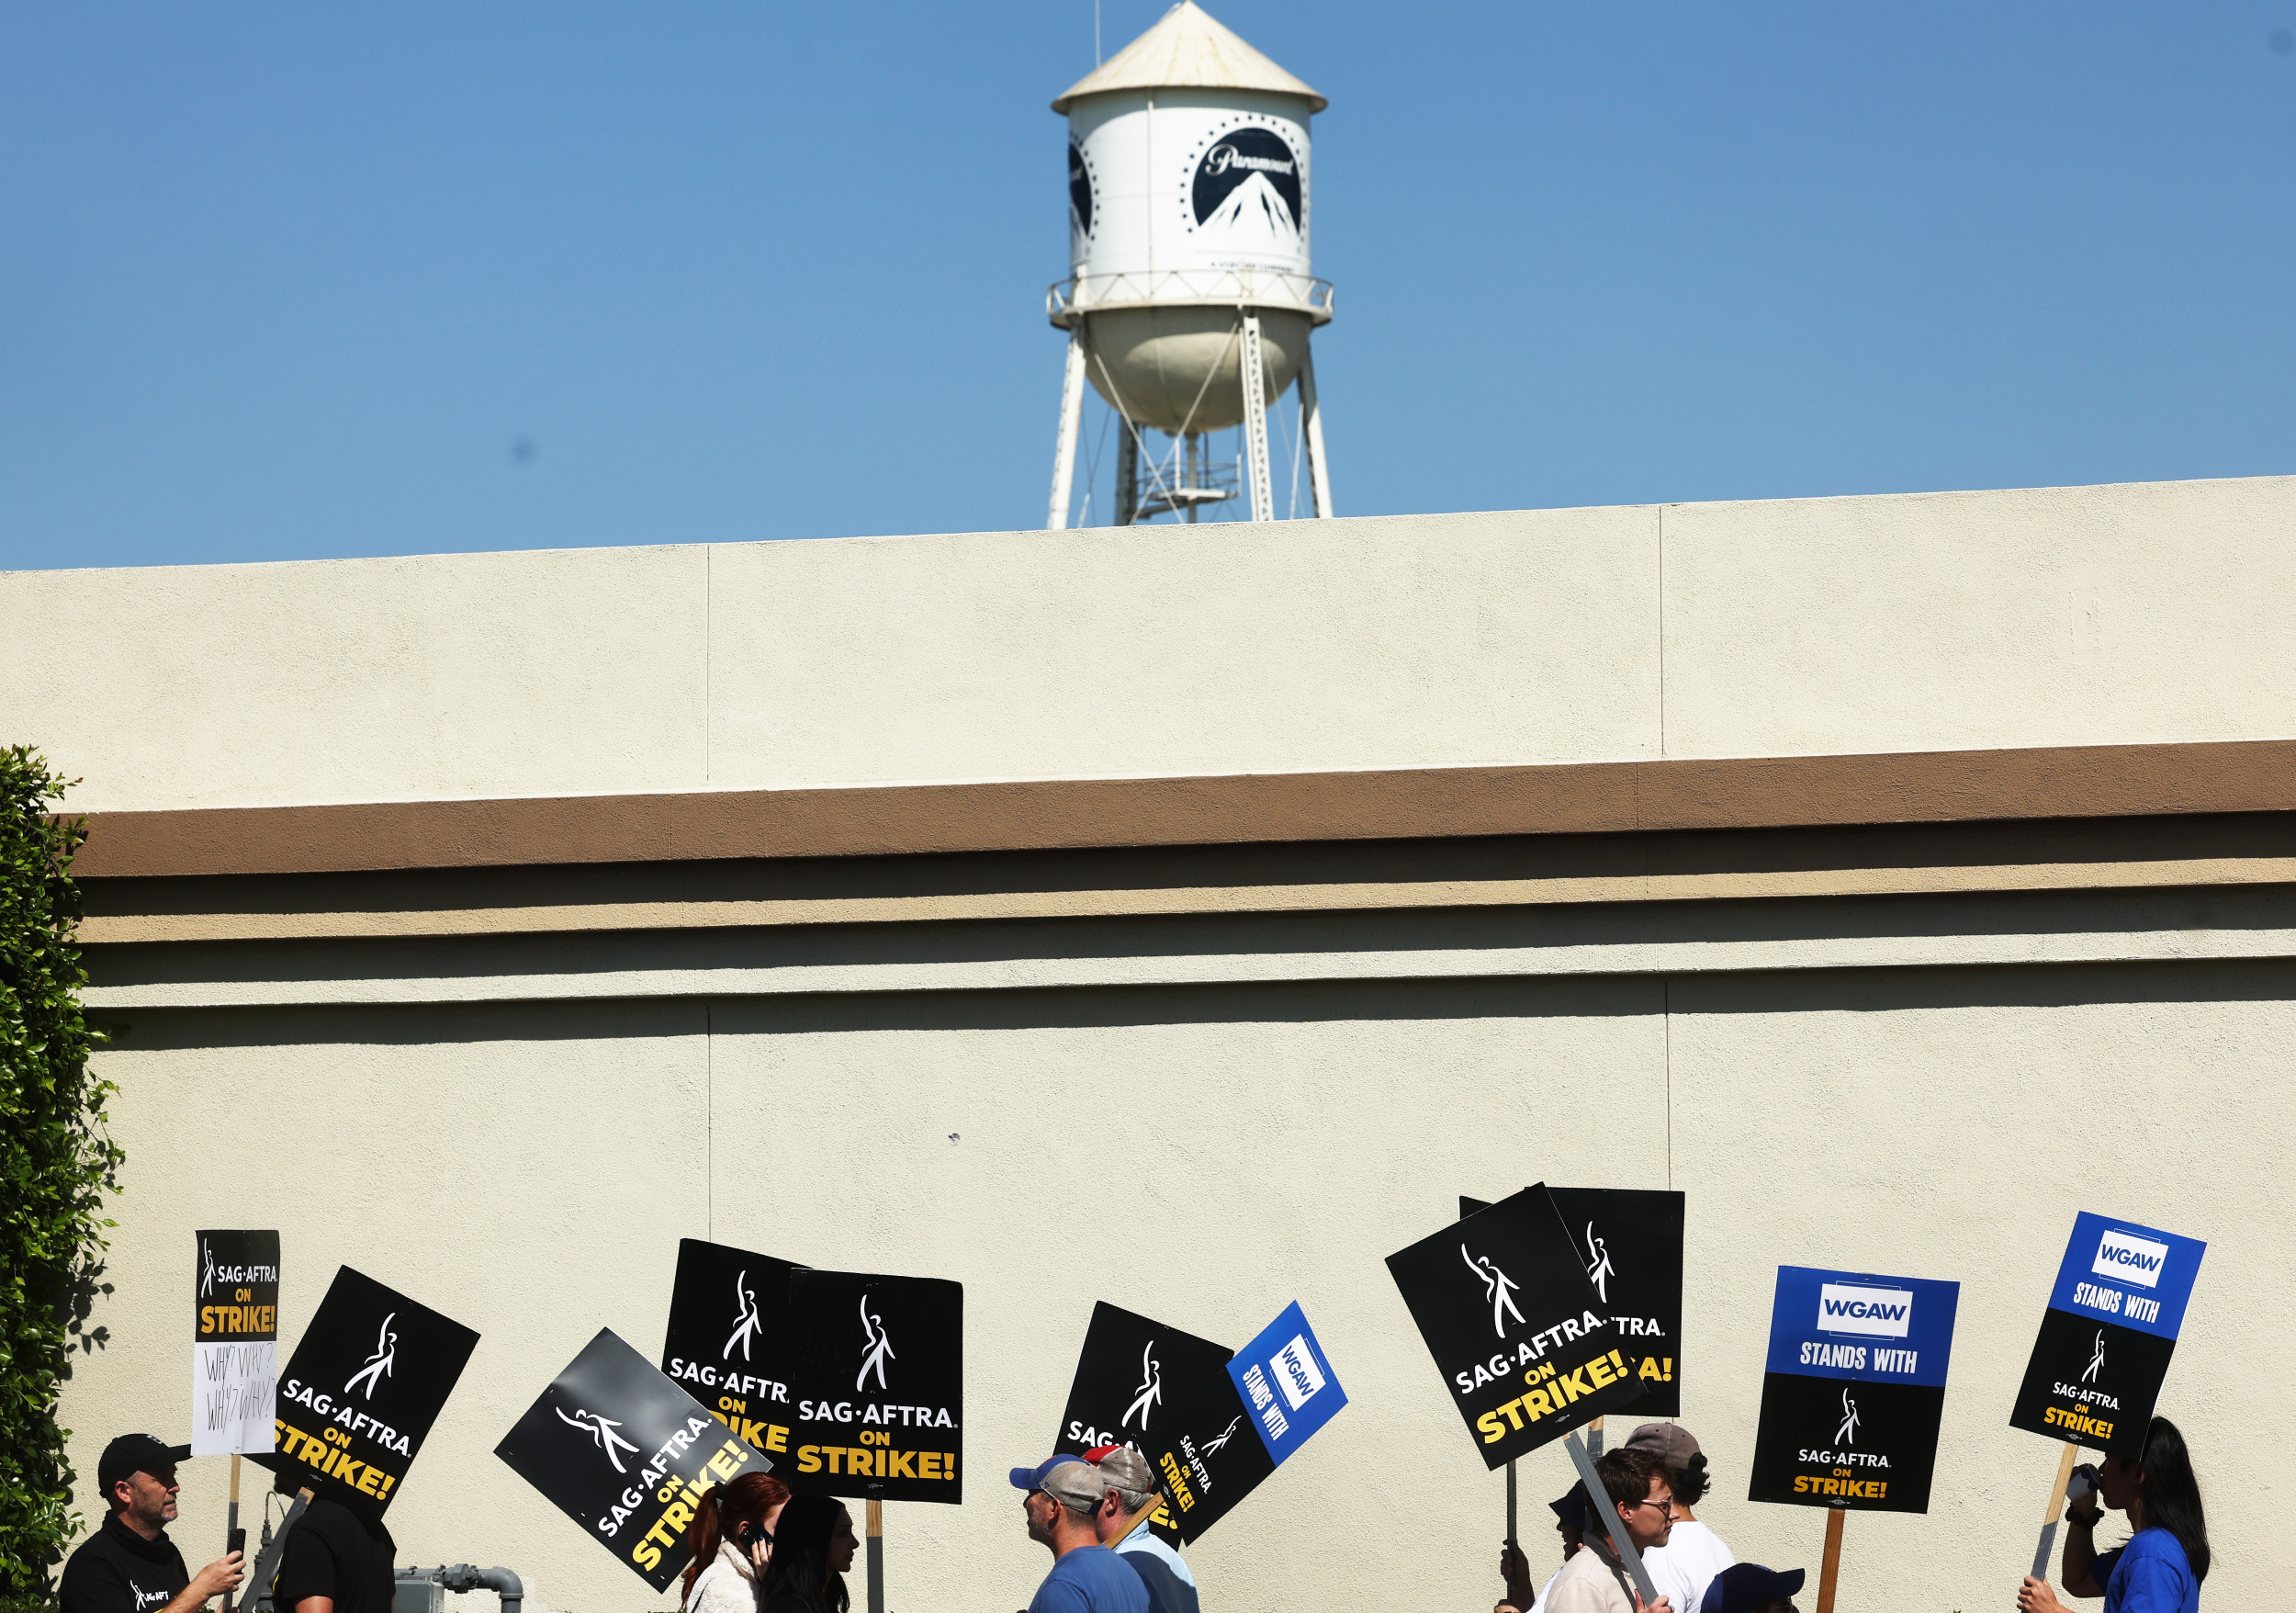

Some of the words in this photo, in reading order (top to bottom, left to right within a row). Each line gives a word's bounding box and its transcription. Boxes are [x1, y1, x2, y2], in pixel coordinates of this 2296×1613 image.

[1205, 143, 1293, 175] Paramount
[2101, 1244, 2162, 1272] WGAW
[235, 1288, 252, 1302] ON
[1824, 1299, 1908, 1321] WGAW
[2073, 1281, 2122, 1314] STANDS
[2123, 1294, 2160, 1324] WITH
[200, 1305, 276, 1333] STRIKE!
[204, 1344, 235, 1387] WHY?
[238, 1343, 274, 1378] WHY?
[1282, 1345, 1314, 1396] WGAW
[1524, 1360, 1557, 1385] ON
[1800, 1341, 1867, 1370] STANDS
[1874, 1348, 1918, 1374] WITH
[207, 1383, 239, 1435] WHY?
[239, 1375, 276, 1421] WHY?
[718, 1396, 747, 1415] ON
[1243, 1363, 1274, 1411] STANDS
[1261, 1402, 1289, 1441] WITH
[1476, 1348, 1628, 1444] STRIKE!
[2074, 1403, 2089, 1414] ON
[2043, 1406, 2114, 1439] STRIKE!
[323, 1427, 352, 1449] ON
[859, 1430, 890, 1446] ON
[796, 1445, 955, 1481] STRIKE!
[1181, 1465, 1192, 1479] ON
[1832, 1468, 1851, 1477] ON
[657, 1473, 684, 1503] ON
[1159, 1451, 1196, 1513] STRIKE!
[1793, 1475, 1887, 1498] STRIKE!
[632, 1438, 748, 1573] STRIKE!
